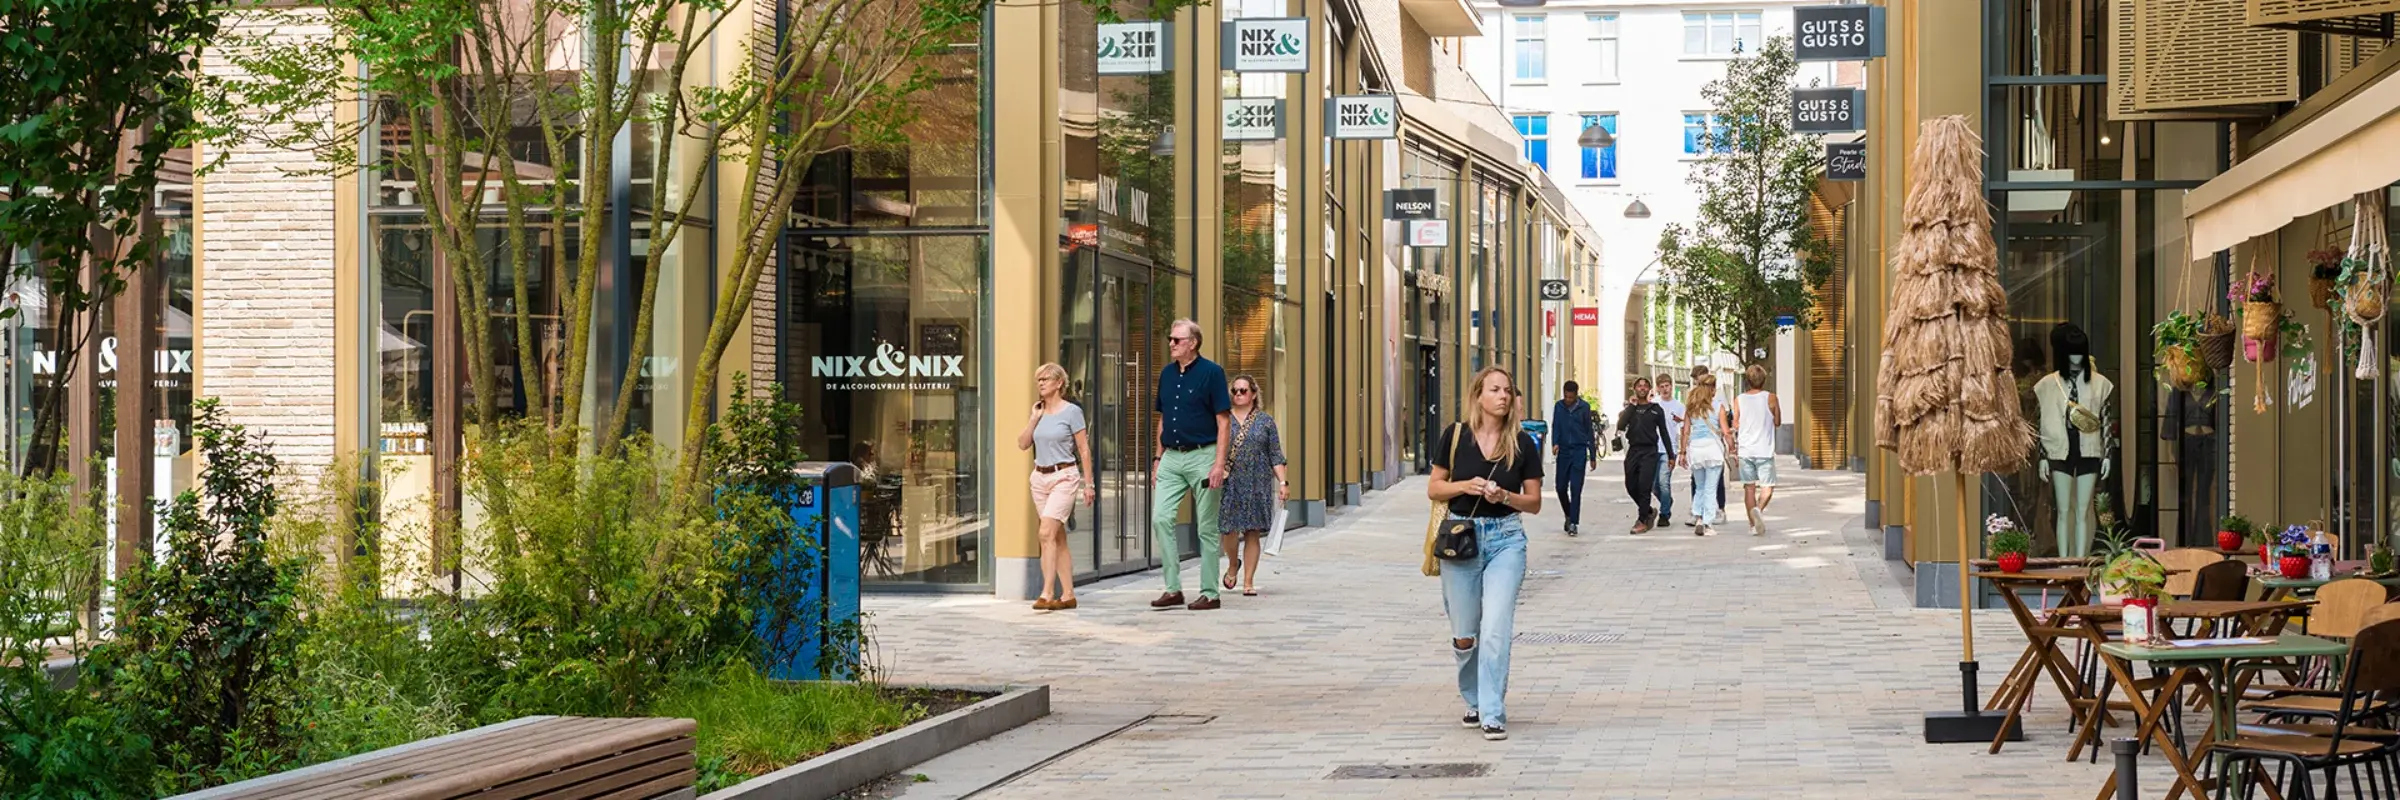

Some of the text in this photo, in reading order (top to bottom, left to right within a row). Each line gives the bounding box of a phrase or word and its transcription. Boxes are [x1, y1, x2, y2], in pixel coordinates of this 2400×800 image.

[1802, 19, 1865, 34] GUTS &
[1241, 29, 1276, 41] NIX
[1802, 33, 1865, 47] GUSTO
[1241, 33, 1300, 56] NIX &
[1341, 104, 1369, 114] NIX
[1798, 99, 1850, 111] GUTS &
[1341, 107, 1389, 126] NIX &
[1798, 110, 1850, 121] GUSTO
[1098, 173, 1149, 228] NIX NIX
[1395, 202, 1432, 211] NELSON
[1574, 313, 1597, 321] HEMA
[811, 342, 965, 377] NIX & NIX
[839, 383, 906, 391] ALCOHOLVRIJE
[908, 383, 951, 391] SLIJTERIJ
